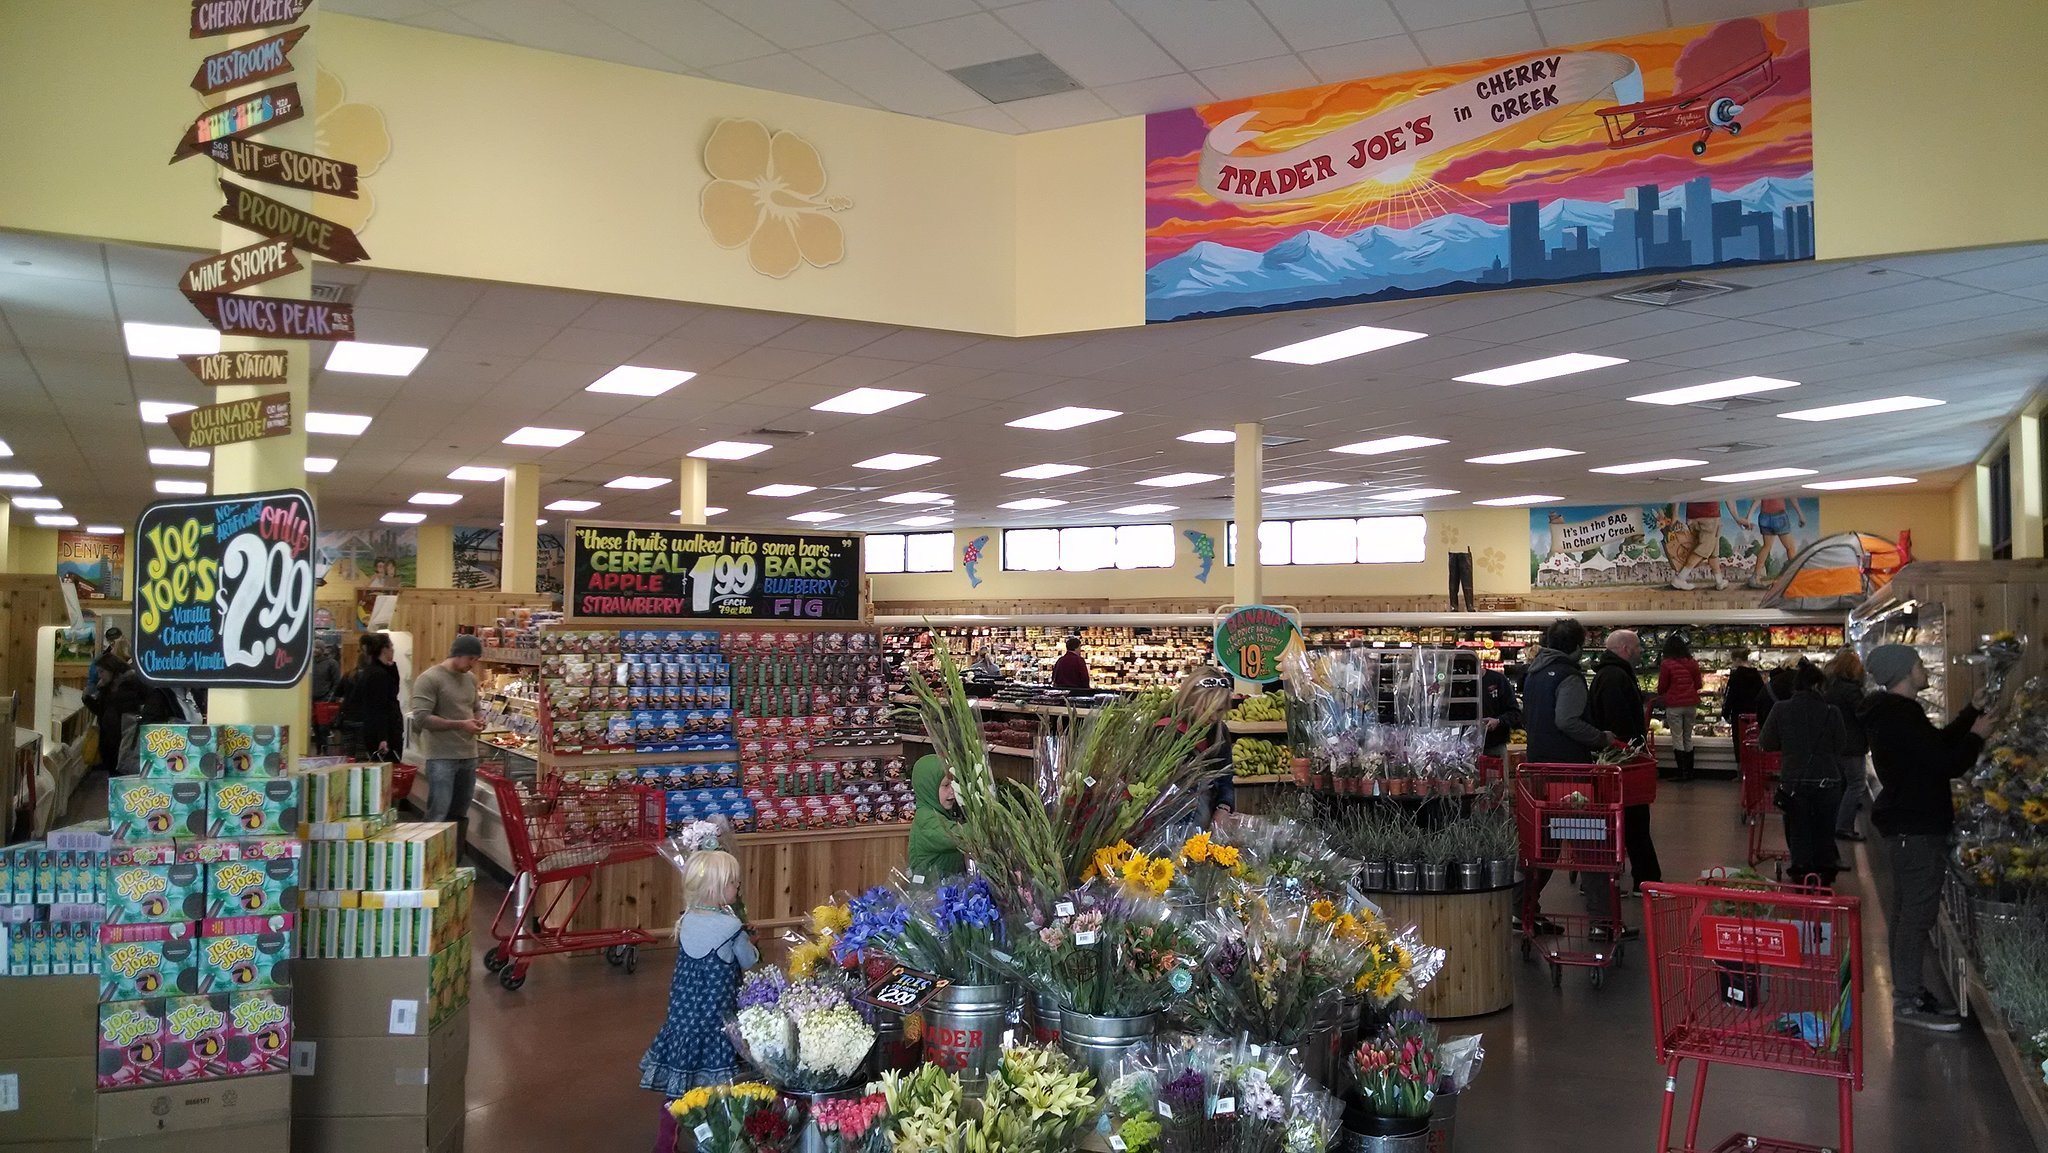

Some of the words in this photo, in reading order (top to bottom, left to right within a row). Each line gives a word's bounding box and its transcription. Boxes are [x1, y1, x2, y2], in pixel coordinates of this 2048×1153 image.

[200, 0, 248, 31] CHERRY
[251, 0, 294, 23] CREEK
[207, 38, 285, 89] RESTROOMS
[1476, 56, 1562, 101] CHERRY
[275, 104, 292, 116] FEET
[1490, 85, 1560, 124] CREEK
[1216, 154, 1338, 198] TRADER
[1346, 115, 1435, 170] JOE'S
[1453, 104, 1473, 124] in
[263, 154, 280, 165] THE
[280, 151, 342, 190] SLOPES
[238, 190, 333, 250] PRODUCE
[231, 241, 288, 283] SHOPPE
[217, 297, 278, 333] LONGS
[282, 303, 332, 334] PEAK
[197, 353, 233, 380] TASTE
[189, 418, 267, 448] ADVENTURE!
[259, 501, 309, 559] only
[1562, 540, 1573, 549] in
[1574, 533, 1606, 548] Cherry
[1608, 524, 1636, 538] Creek
[1563, 528, 1577, 538] It's
[1579, 525, 1589, 534] in
[1590, 520, 1606, 531] the
[1608, 513, 1628, 525] BAG
[63, 542, 120, 560] DENVER
[624, 530, 668, 552] fruits
[671, 533, 724, 554] walked
[730, 535, 758, 555] into
[762, 541, 796, 556] some
[590, 550, 687, 574] CEREAL
[764, 557, 832, 578] BARS
[139, 556, 219, 633] Joe's
[588, 572, 664, 591] APPLE
[764, 577, 838, 596] BLUEBERRY
[173, 605, 211, 625] Vanilla
[582, 595, 685, 615] STRAWBERRY
[774, 598, 824, 617] FIG
[739, 606, 754, 614] BOX
[162, 626, 214, 646] Chocolate
[156, 733, 187, 758] Joe's
[135, 791, 172, 818] Joe's
[229, 790, 265, 815] Joe's
[130, 874, 167, 902] Joe's
[228, 870, 265, 896] Joe's
[123, 951, 162, 978] Joe's
[219, 944, 257, 971] Joe's
[118, 1015, 161, 1046] Joe's
[183, 1010, 224, 1041] Joe's
[246, 1005, 286, 1033] Joe's
